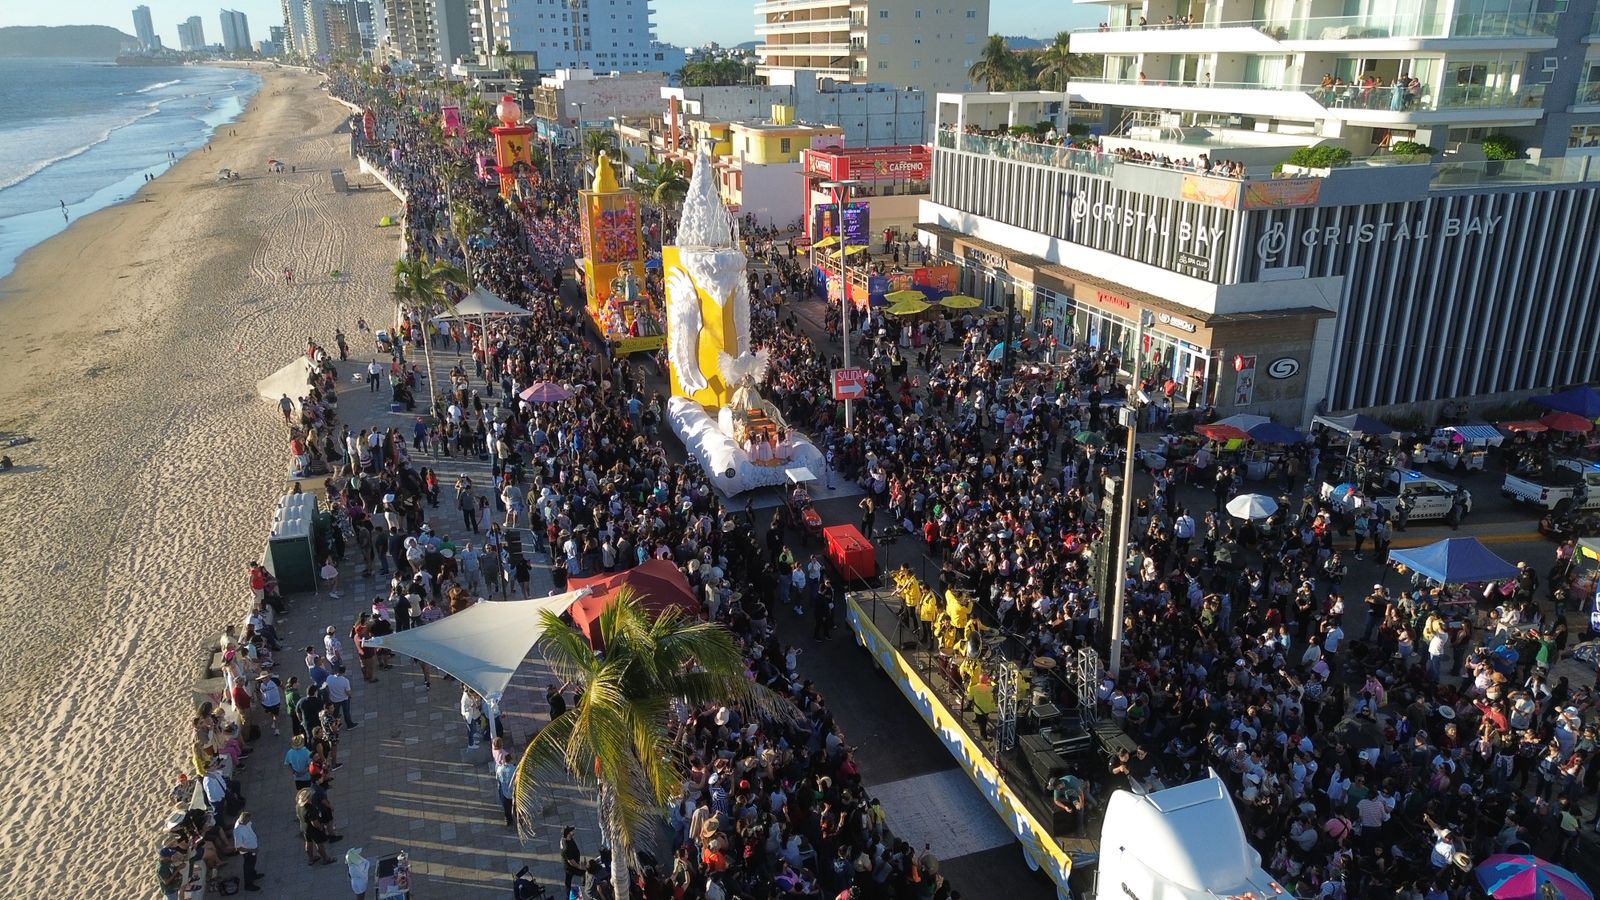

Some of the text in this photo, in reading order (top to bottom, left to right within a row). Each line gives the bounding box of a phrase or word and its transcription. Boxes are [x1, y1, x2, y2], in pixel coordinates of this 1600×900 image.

[889, 162, 923, 172] CAFFENIO
[1092, 202, 1224, 246] CRISTAL BAY
[1301, 215, 1502, 247] CRISTAL BAY
[837, 370, 863, 381] SALIDA
